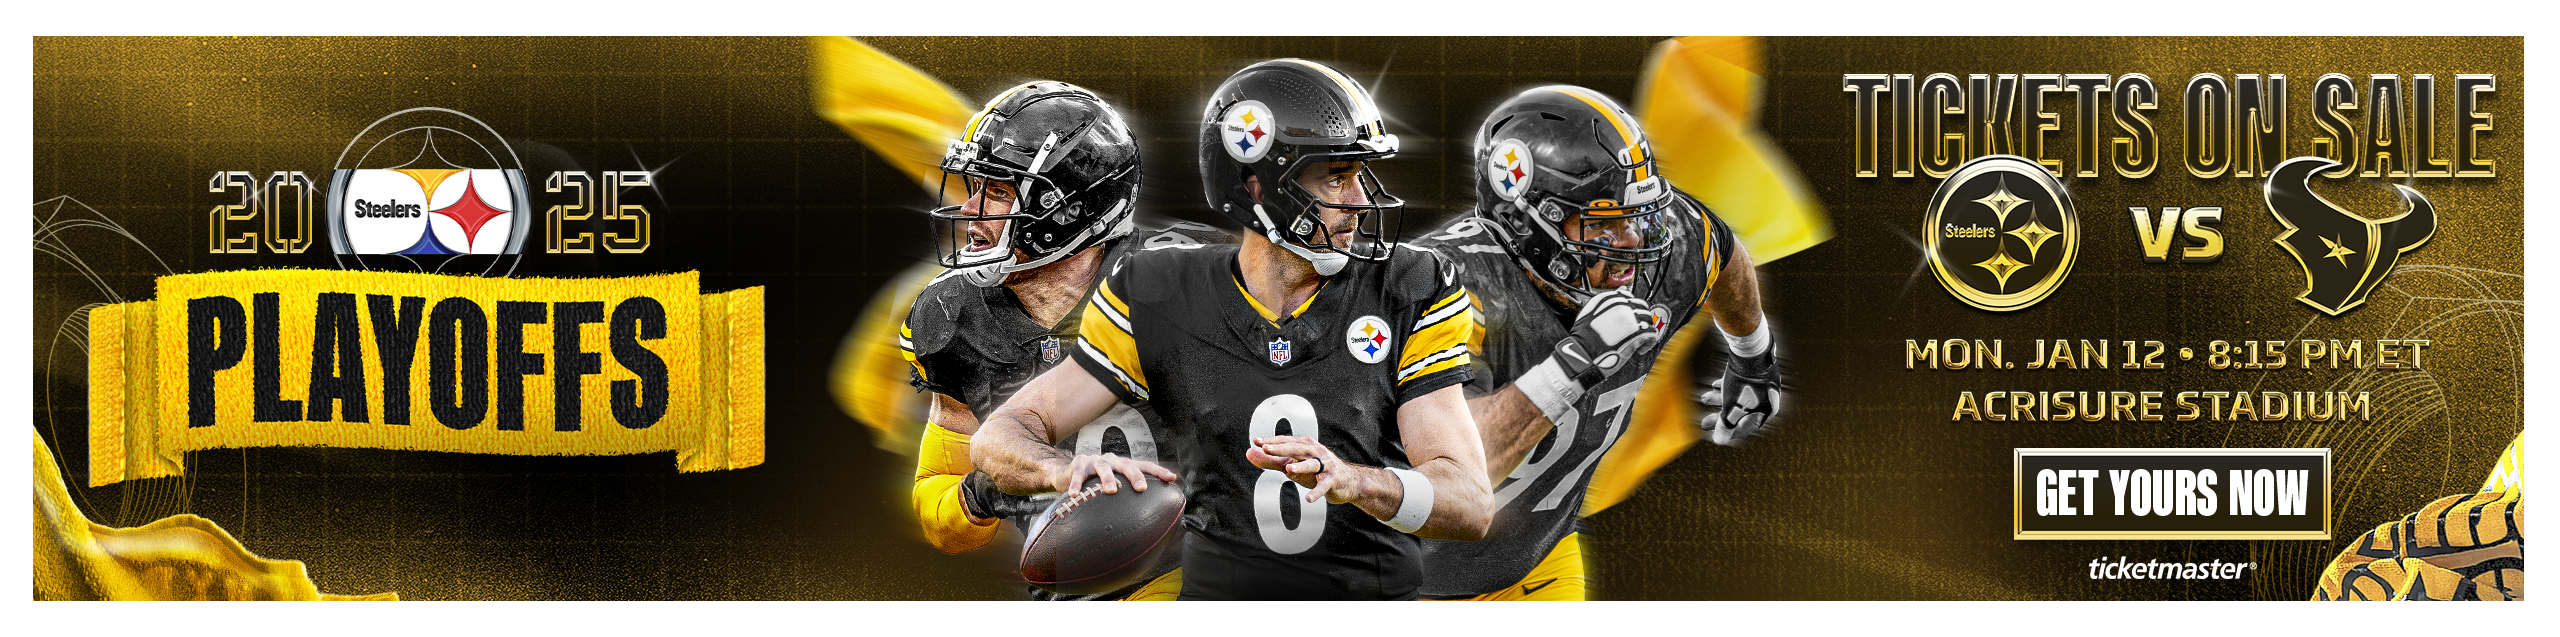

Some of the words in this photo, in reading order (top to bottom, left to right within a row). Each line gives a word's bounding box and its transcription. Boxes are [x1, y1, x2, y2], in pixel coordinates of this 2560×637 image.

[1843, 73, 2159, 179] TICKETS
[2184, 73, 2288, 179] ON
[2311, 73, 2496, 179] SALE
[1636, 182, 1656, 195] Steelers
[209, 170, 312, 254] 20
[354, 198, 421, 221] Steelers
[545, 170, 651, 254] 25
[1945, 223, 1996, 240] Steelers
[2129, 206, 2224, 263] VS
[187, 291, 670, 432] PLAYOFFS
[1044, 348, 1058, 359] NFL
[1273, 350, 1288, 360] NFL
[1905, 339, 2015, 371] MON.
[2027, 339, 2109, 371] JAN
[2122, 339, 2166, 371] 12
[2209, 339, 2288, 371] 8:15
[2301, 339, 2363, 371] PM
[2376, 339, 2430, 371] ET
[1951, 390, 2164, 423] ACRISURE
[2175, 390, 2371, 423] STADIUM
[1249, 393, 1327, 555] 8
[2036, 468, 2099, 517] GET
[2108, 468, 2218, 517] YOURS
[2229, 468, 2309, 517] NOW
